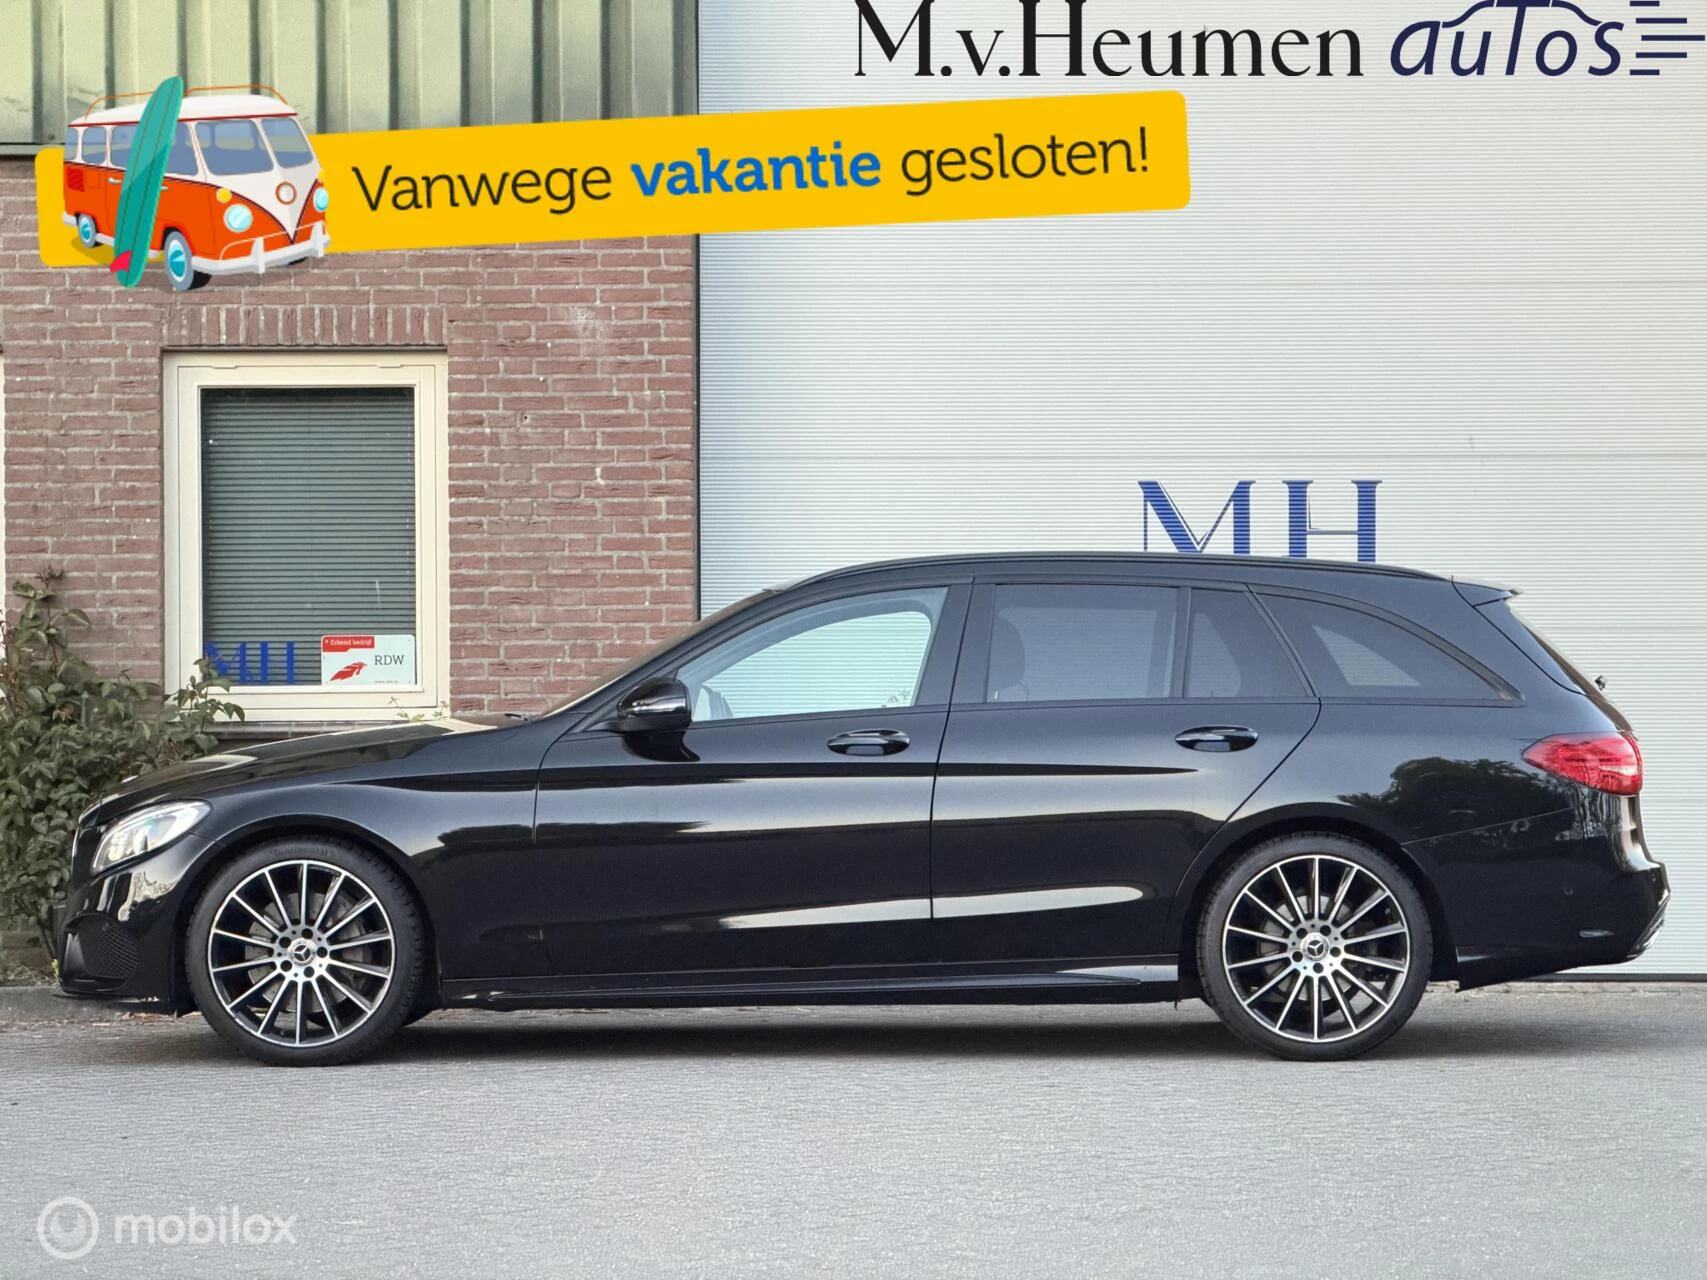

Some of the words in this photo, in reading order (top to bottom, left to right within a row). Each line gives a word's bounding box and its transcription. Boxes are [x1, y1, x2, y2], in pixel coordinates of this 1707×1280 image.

[854, 0, 1364, 77] M.v.Heumen
[1137, 480, 1382, 562] MH
[352, 639, 372, 647] bedrijf
[374, 654, 405, 666] RDW
